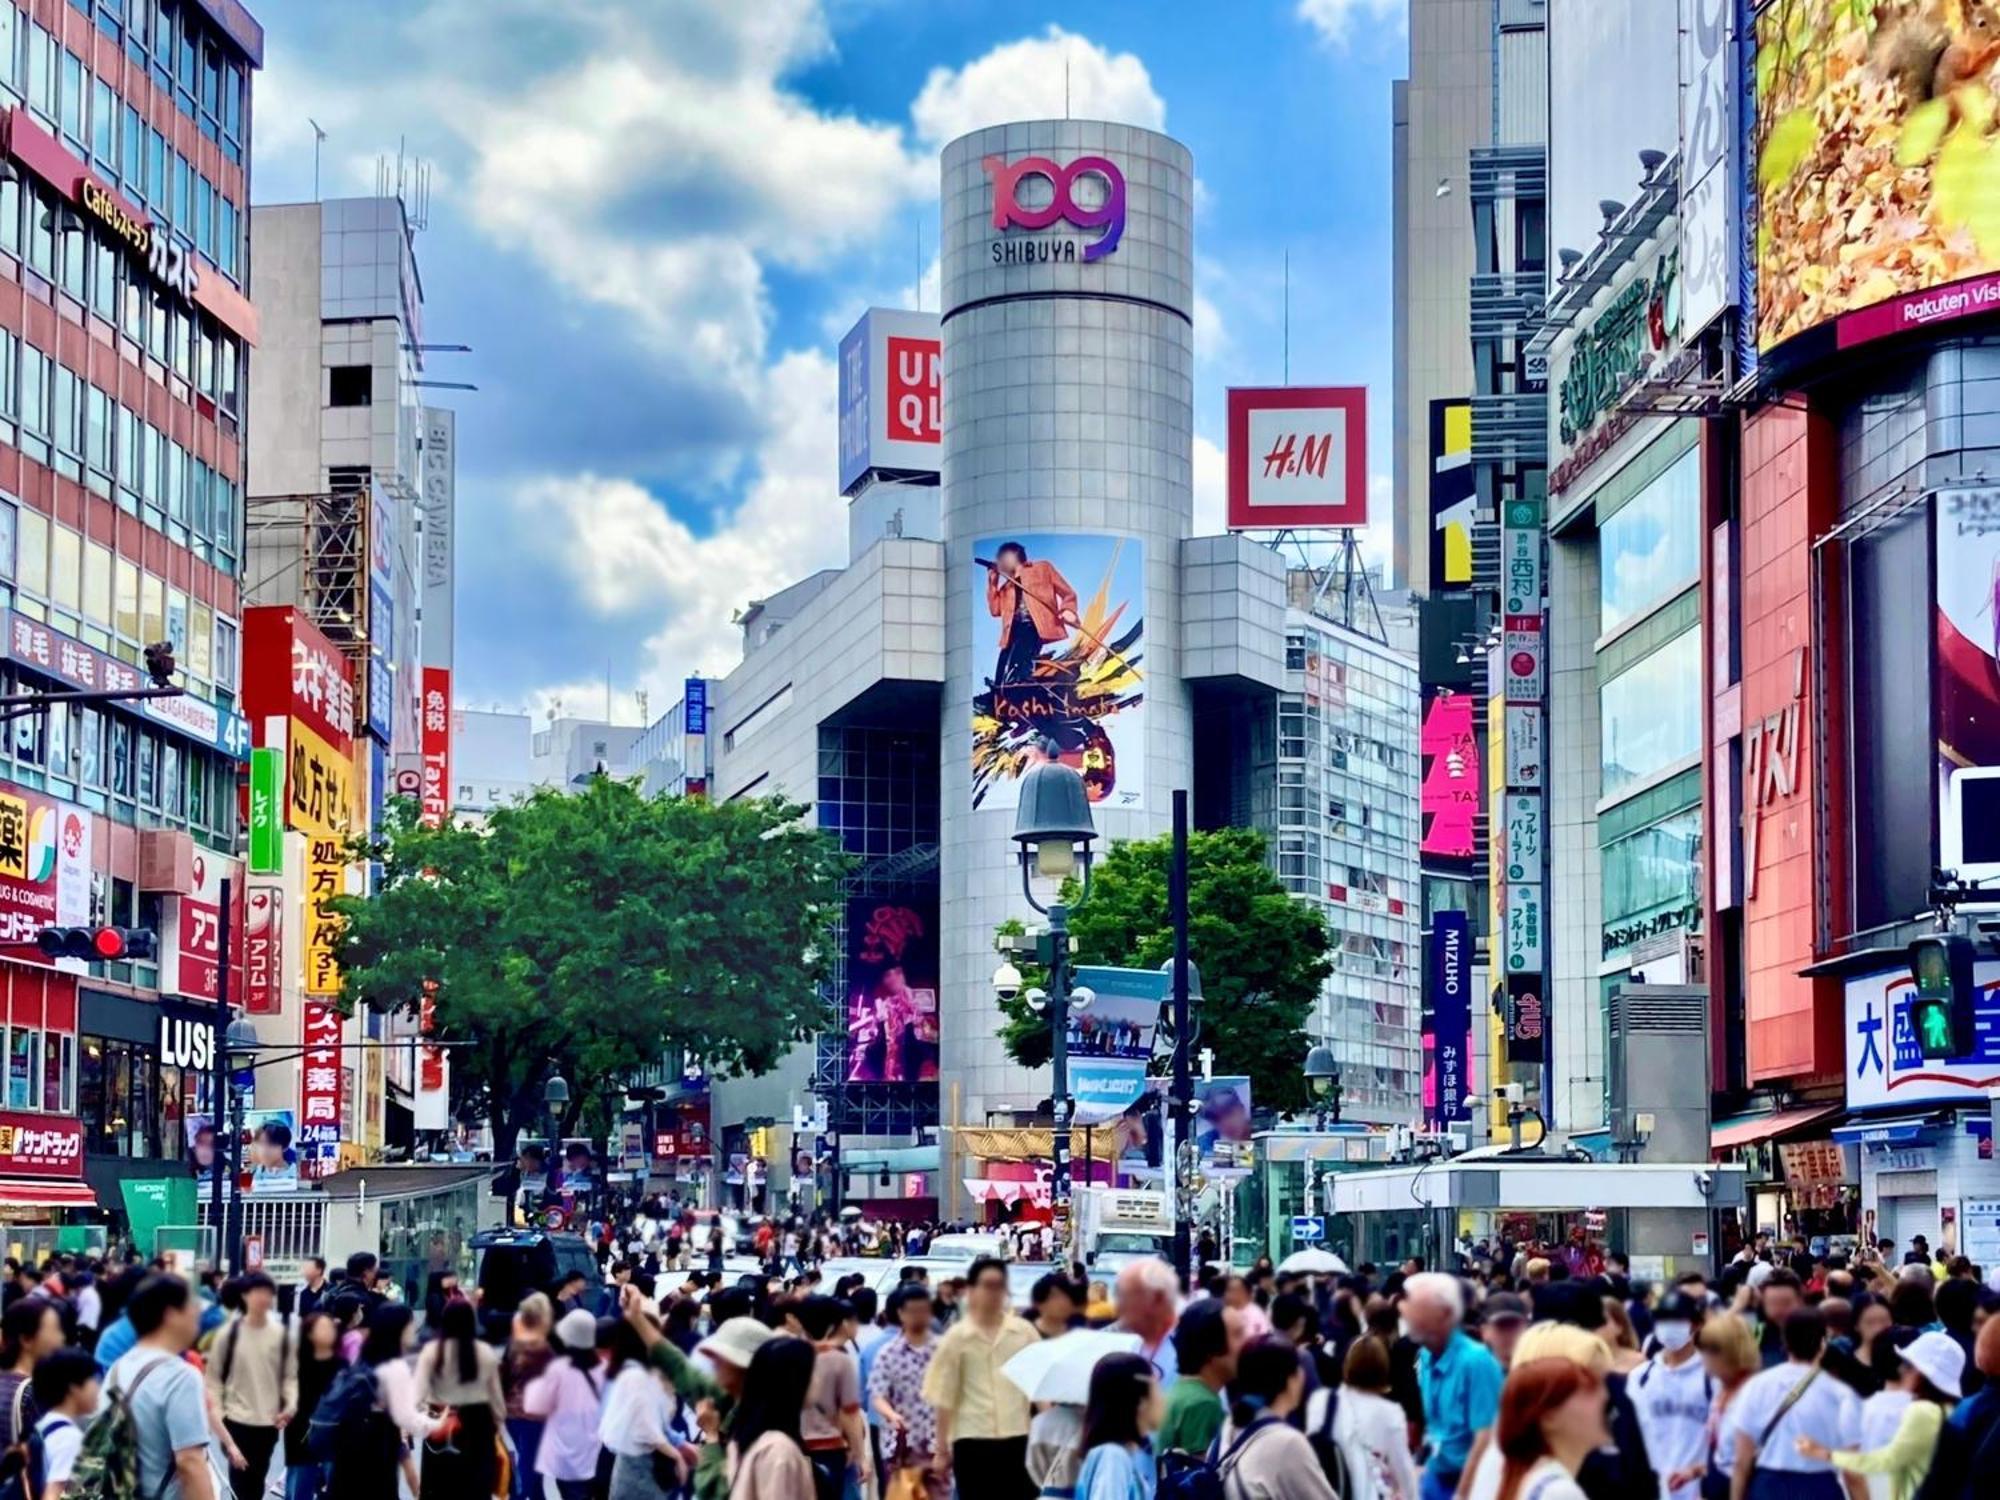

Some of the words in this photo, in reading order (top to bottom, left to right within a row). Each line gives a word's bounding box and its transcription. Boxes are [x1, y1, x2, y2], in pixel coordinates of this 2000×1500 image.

[981, 155, 1126, 264] 109
[149, 229, 199, 300] ガスト
[992, 240, 1075, 264] SHIBUYA
[1904, 293, 1968, 321] Rakuten
[899, 350, 941, 386] UN
[899, 394, 941, 436] QL
[1263, 434, 1332, 479] H&M
[427, 474, 448, 588] CAMERA
[224, 714, 249, 755] 4F
[251, 938, 267, 987] アコム
[1445, 929, 1460, 994] MIZUHO
[307, 1006, 337, 1119] スギ薬局
[1443, 1046, 1458, 1117] みずほ銀行
[24, 1130, 80, 1158] サンドラッグ
